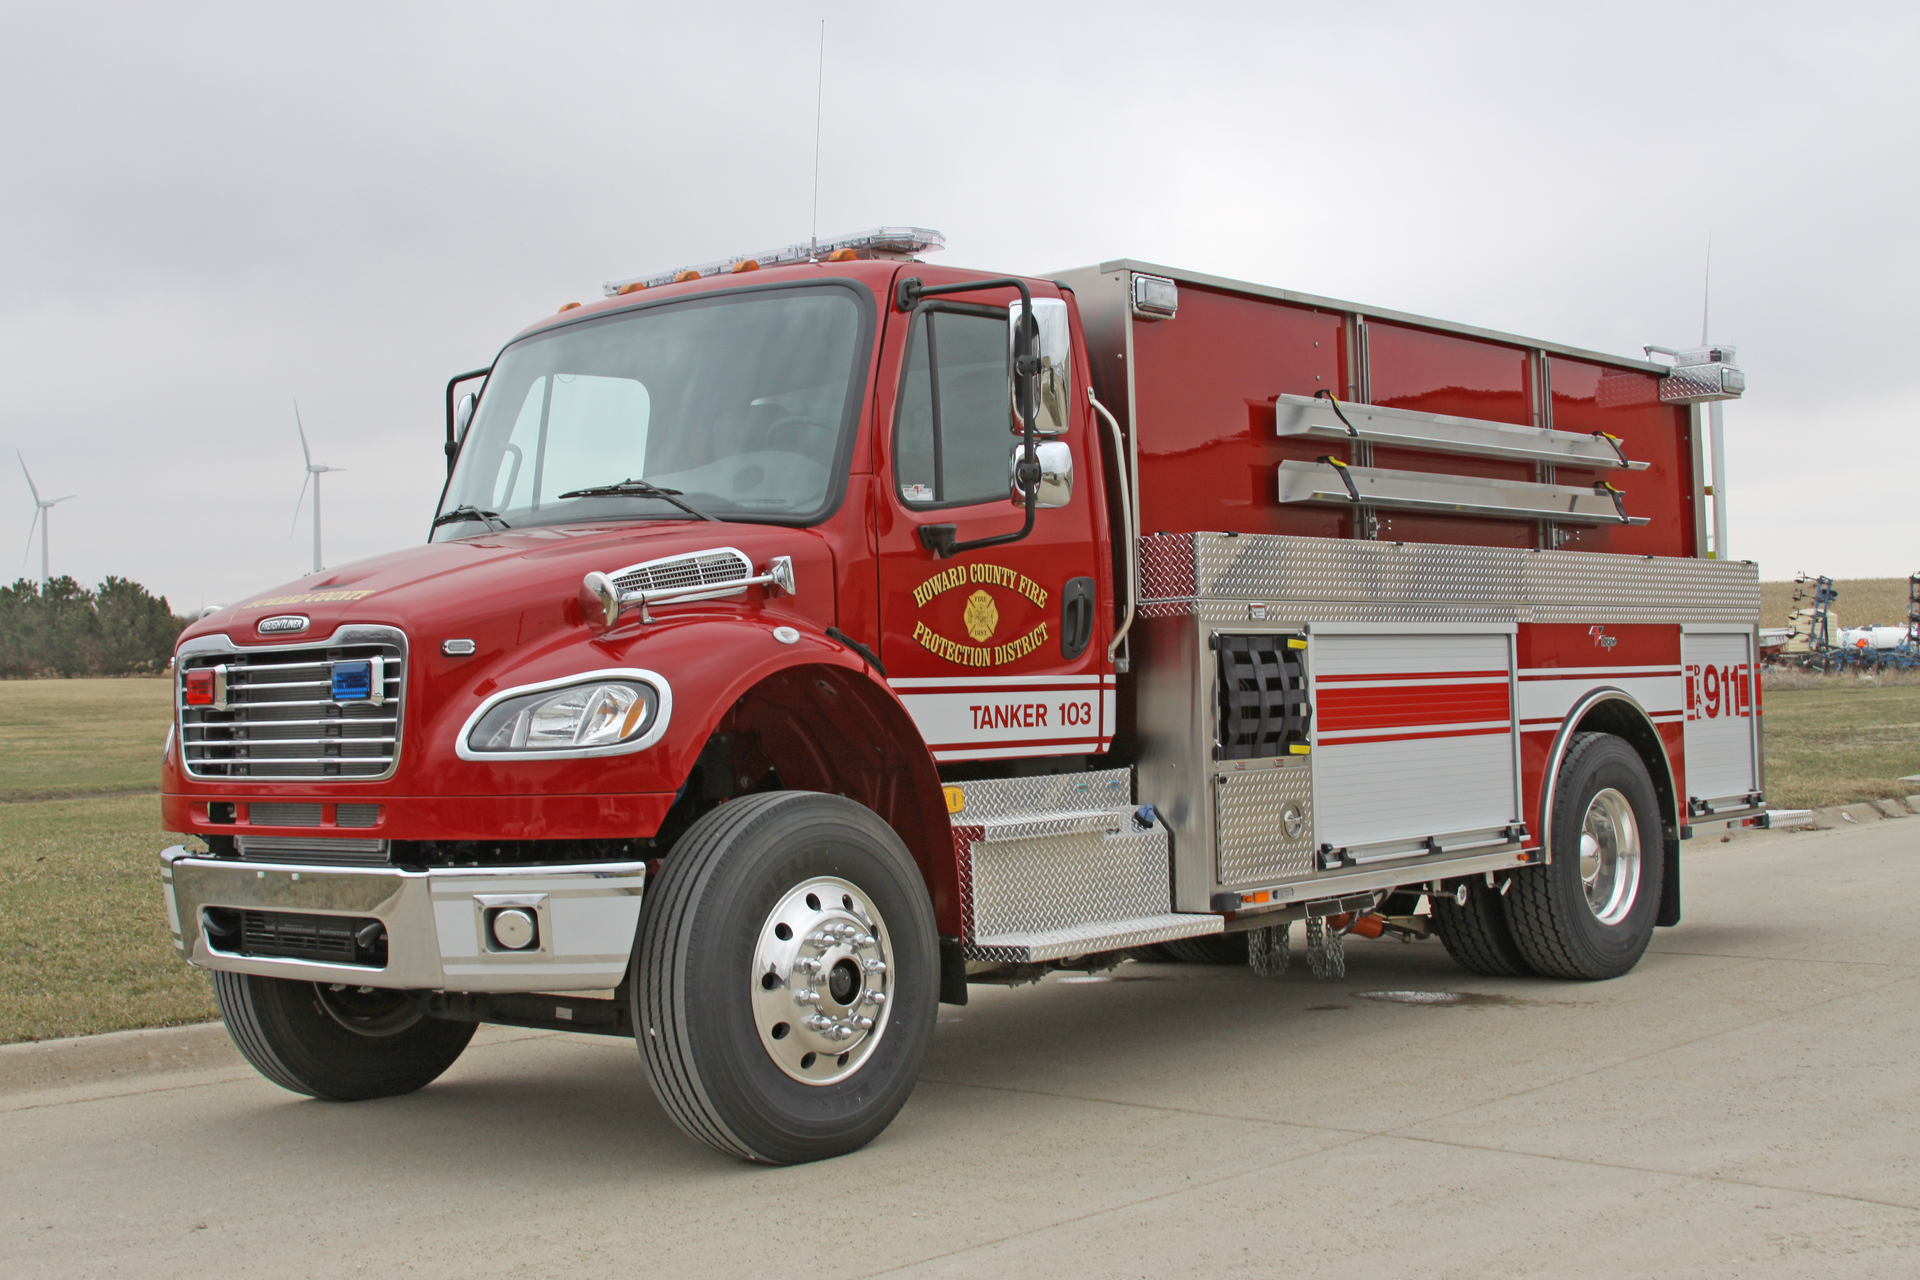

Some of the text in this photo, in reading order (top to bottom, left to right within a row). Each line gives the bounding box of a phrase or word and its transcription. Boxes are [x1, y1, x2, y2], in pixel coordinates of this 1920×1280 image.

[912, 563, 1048, 609] HOWARD COUNTY FIRE
[974, 595, 987, 603] FIRE
[260, 619, 303, 630] FREIGHTLINER
[912, 621, 1049, 667] PROTECTION DISTRICT
[1694, 664, 1740, 720] DIAL 911
[969, 702, 1092, 729] TANKER 103
